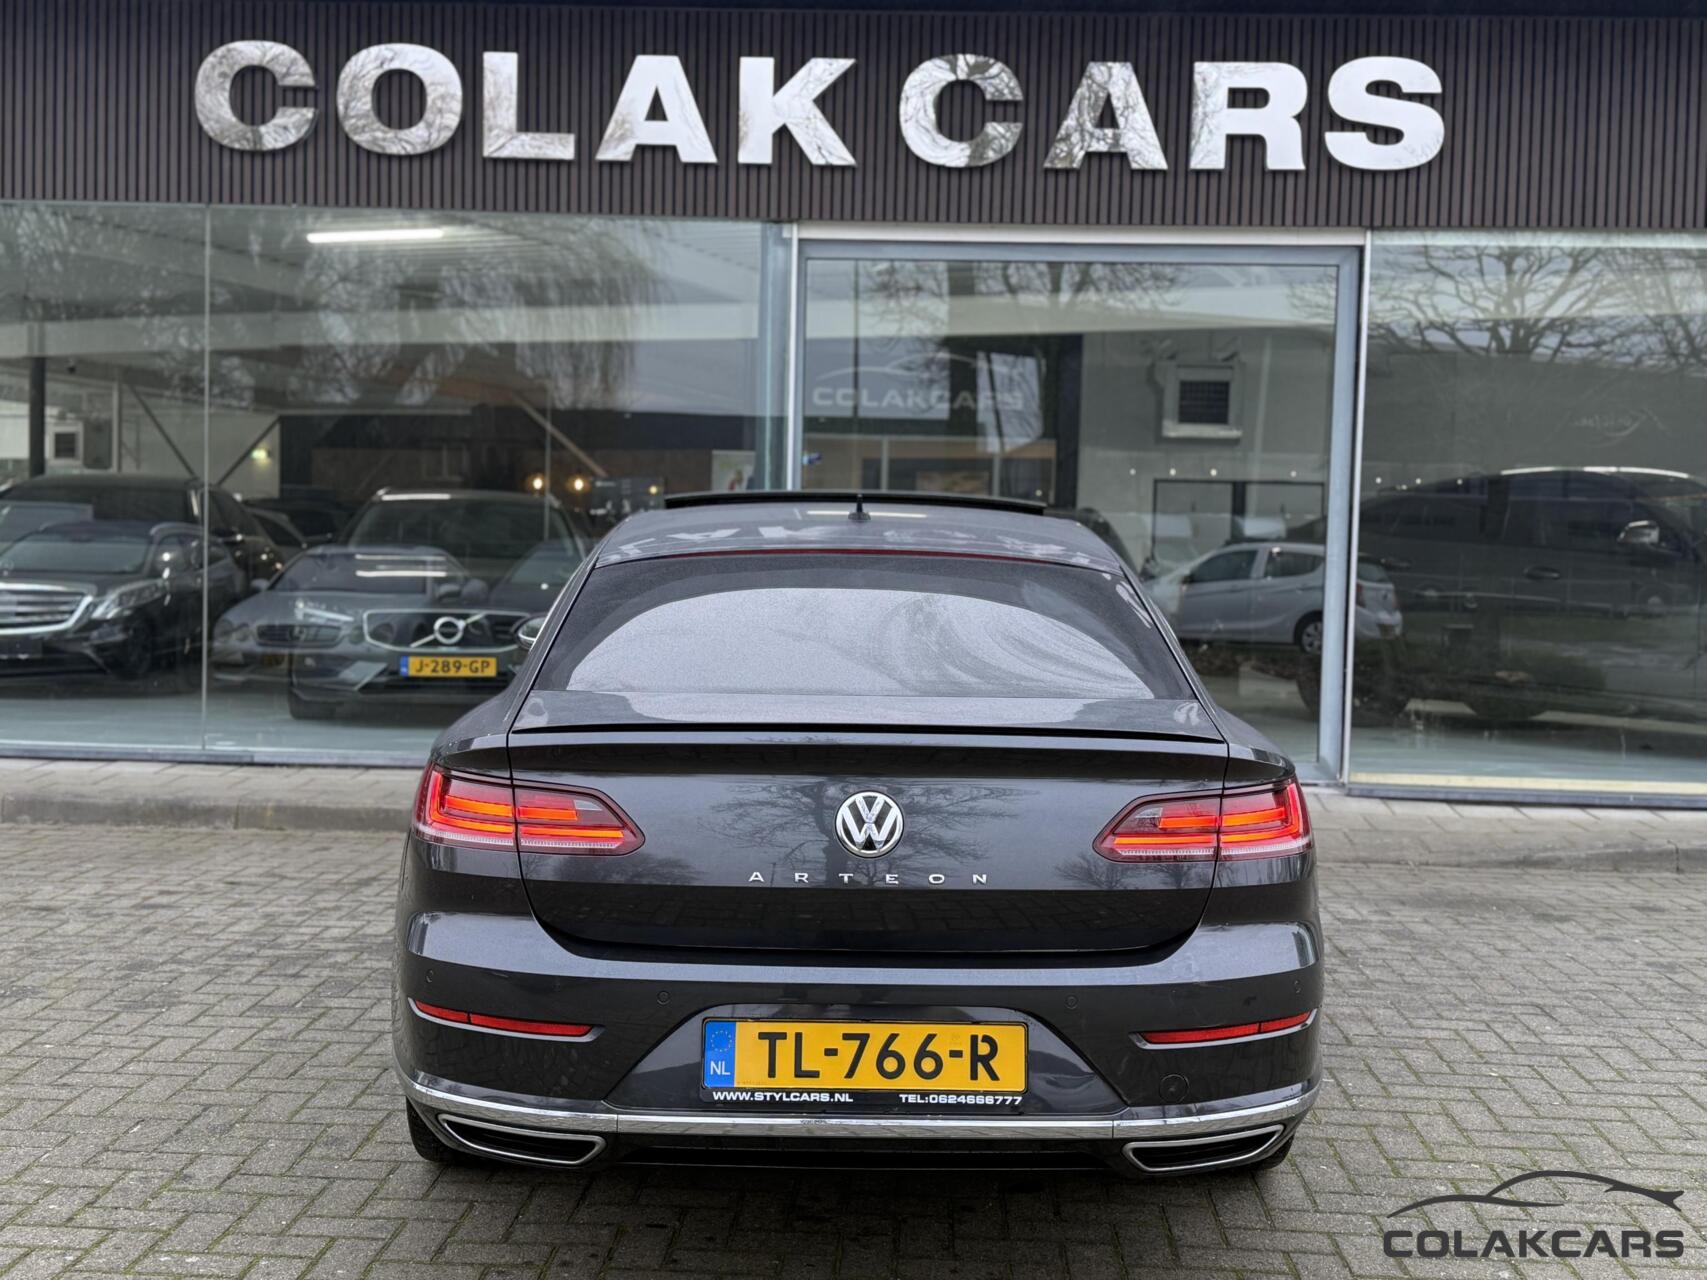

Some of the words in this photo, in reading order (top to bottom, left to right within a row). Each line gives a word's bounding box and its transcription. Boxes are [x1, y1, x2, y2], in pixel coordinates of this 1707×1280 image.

[195, 41, 859, 168] COLAK
[899, 53, 1446, 172] CARS
[415, 660, 490, 673] J-289-GP
[749, 872, 988, 885] ARTEON
[757, 1031, 1000, 1081] TL-766-R
[710, 1060, 731, 1076] NL
[712, 1091, 853, 1103] WWW.STYLCARS.NL
